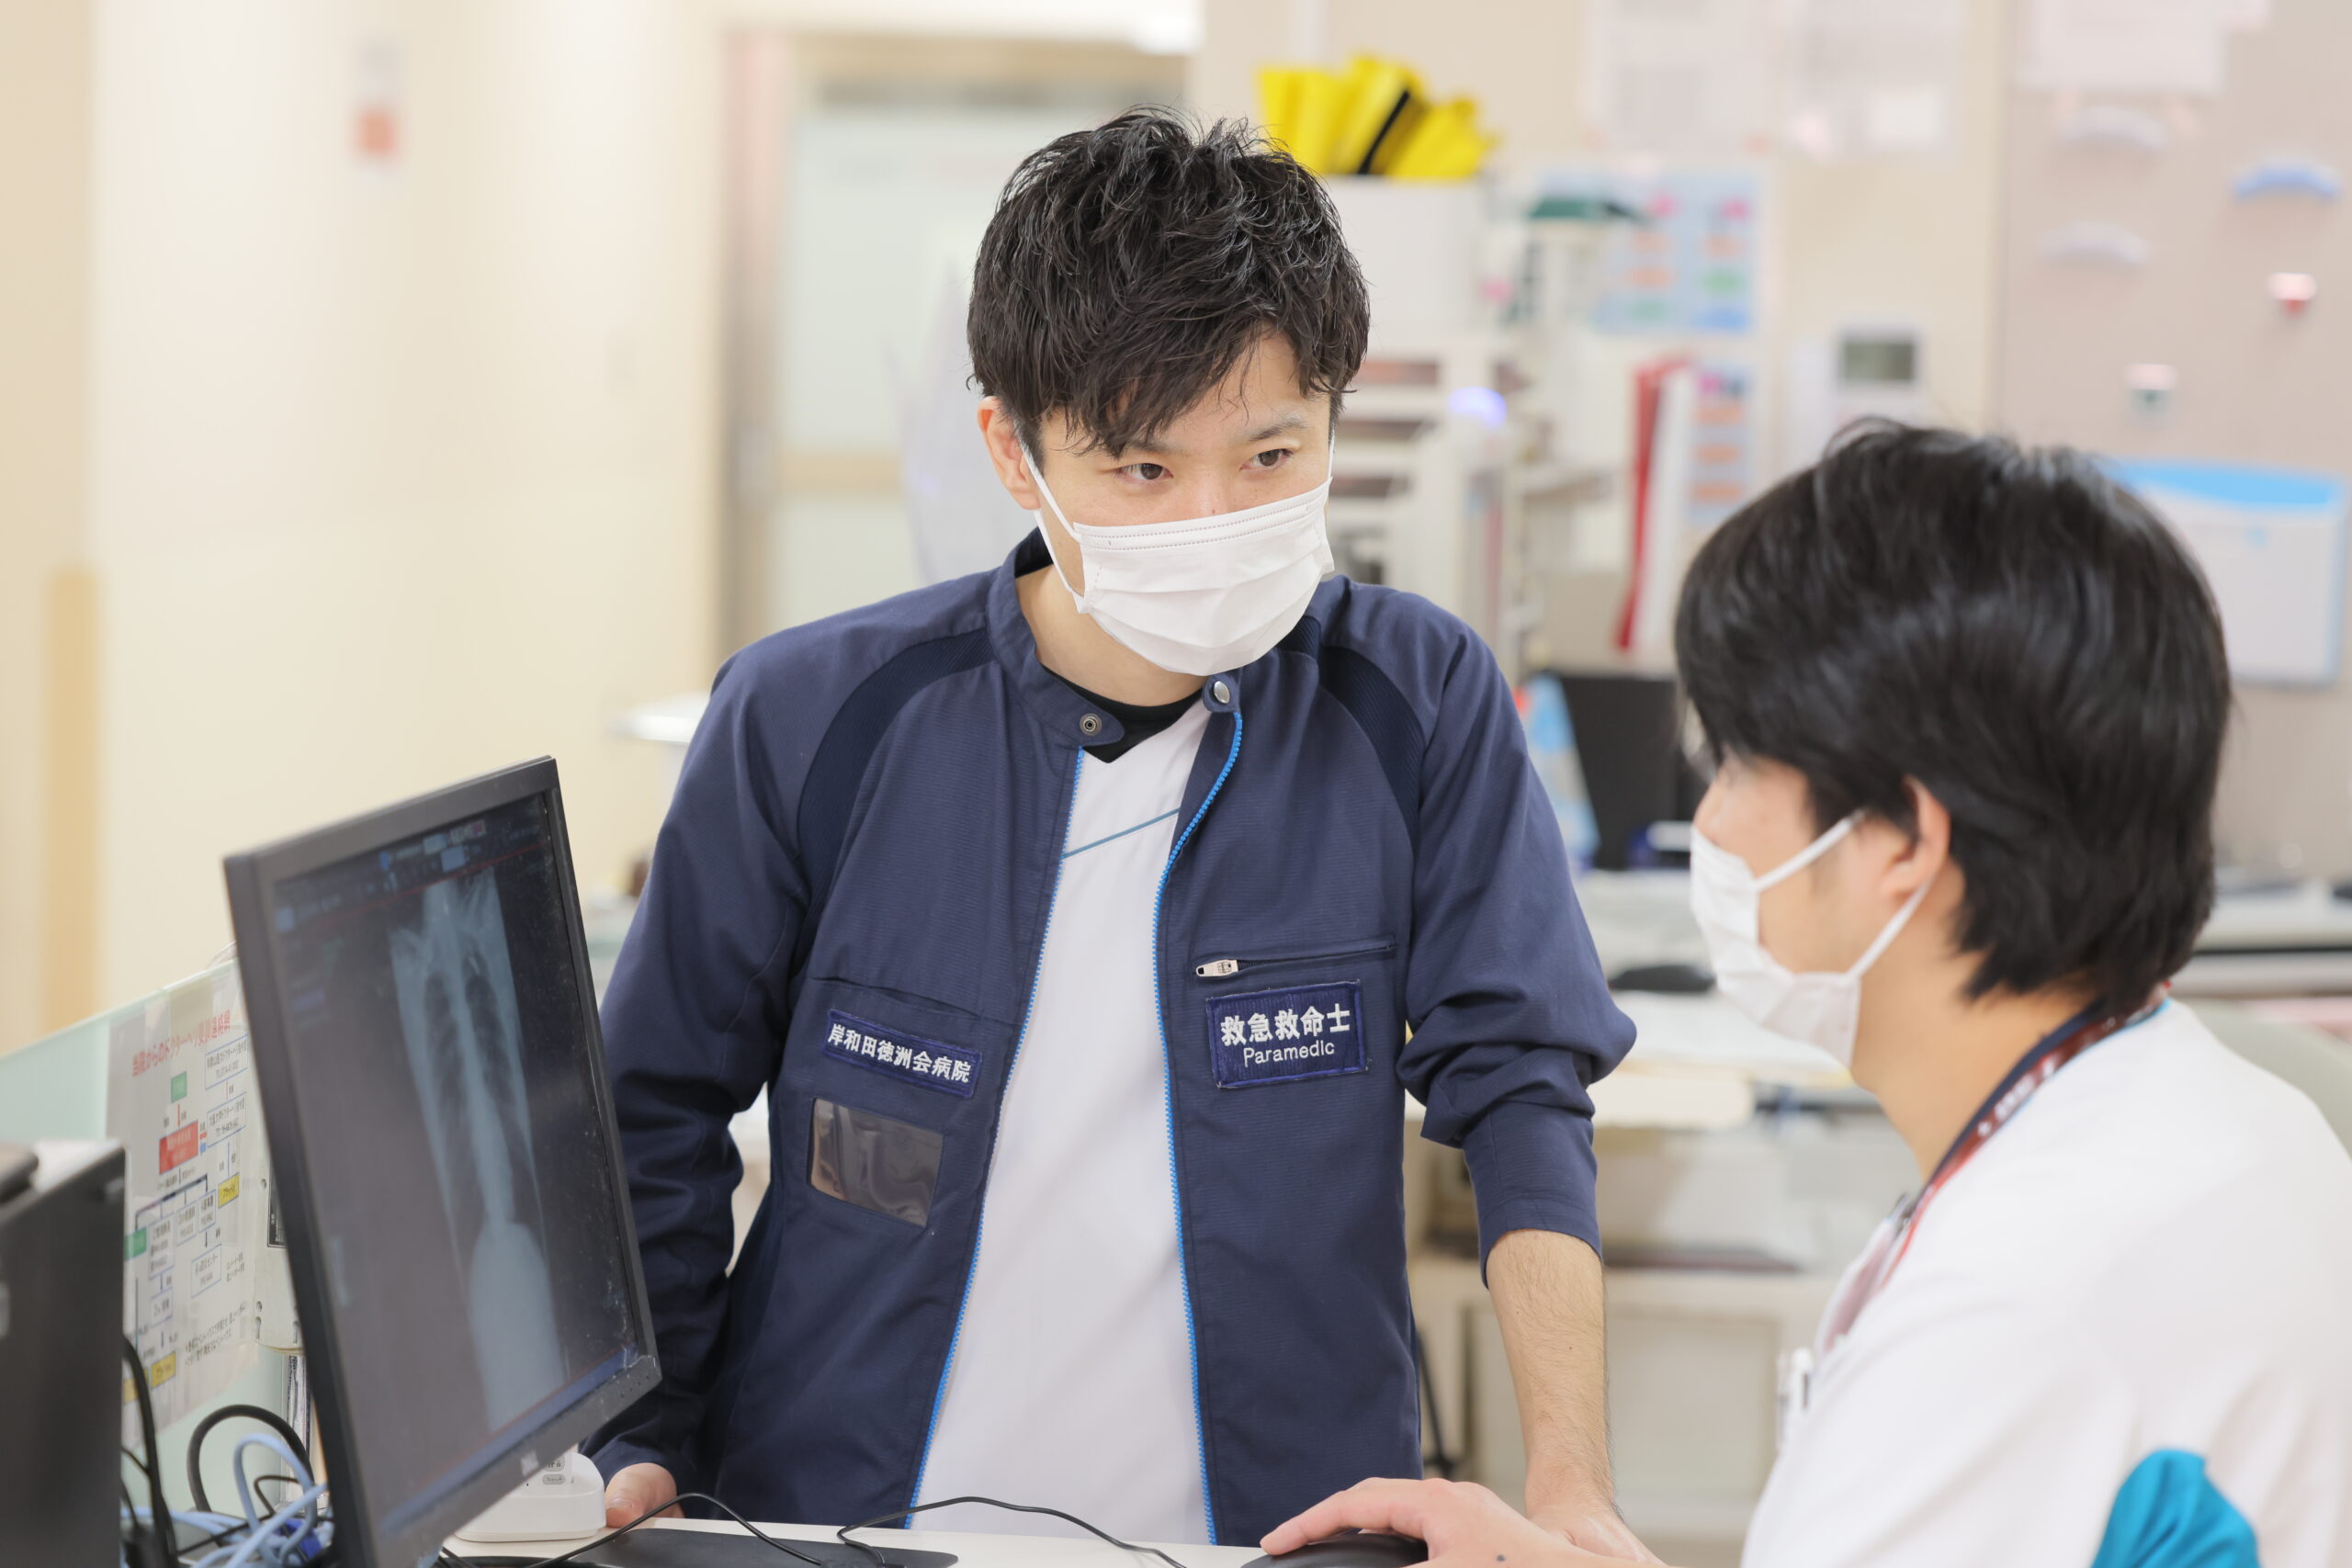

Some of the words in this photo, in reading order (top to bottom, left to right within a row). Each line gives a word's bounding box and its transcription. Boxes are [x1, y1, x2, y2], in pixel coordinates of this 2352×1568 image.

[1220, 1003, 1351, 1046] 救急救命士
[827, 1023, 972, 1083] 岸和田徳洲会病院
[1243, 1040, 1335, 1067] Paramedic
